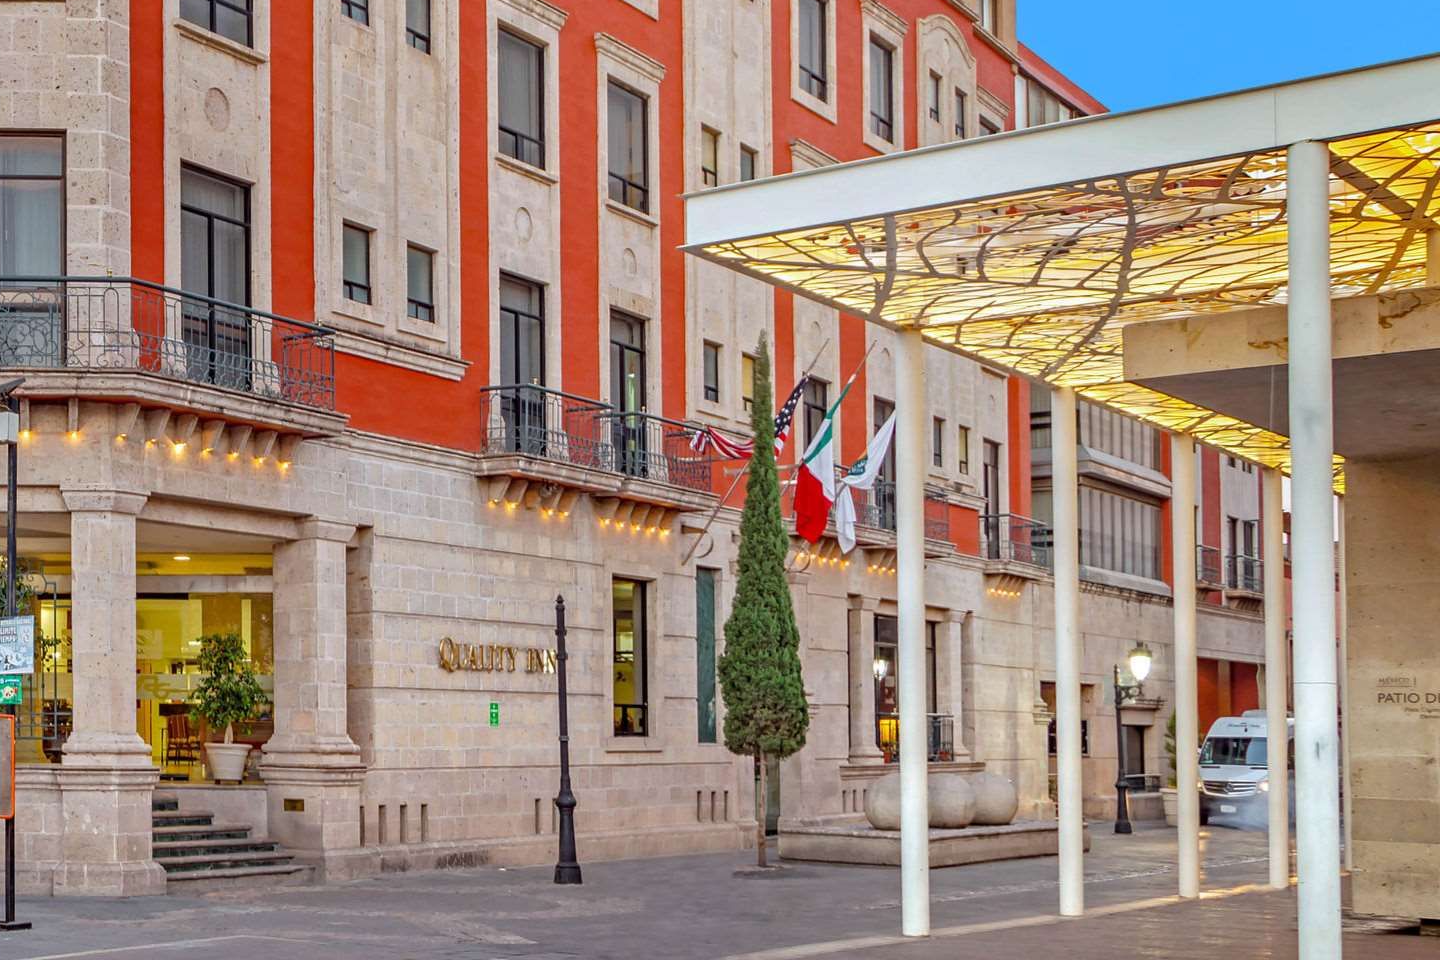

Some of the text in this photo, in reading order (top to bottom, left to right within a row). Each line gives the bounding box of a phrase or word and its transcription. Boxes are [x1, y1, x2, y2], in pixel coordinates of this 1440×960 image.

[439, 637, 557, 675] QUALITY INN
[1377, 692, 1420, 704] PATIO
